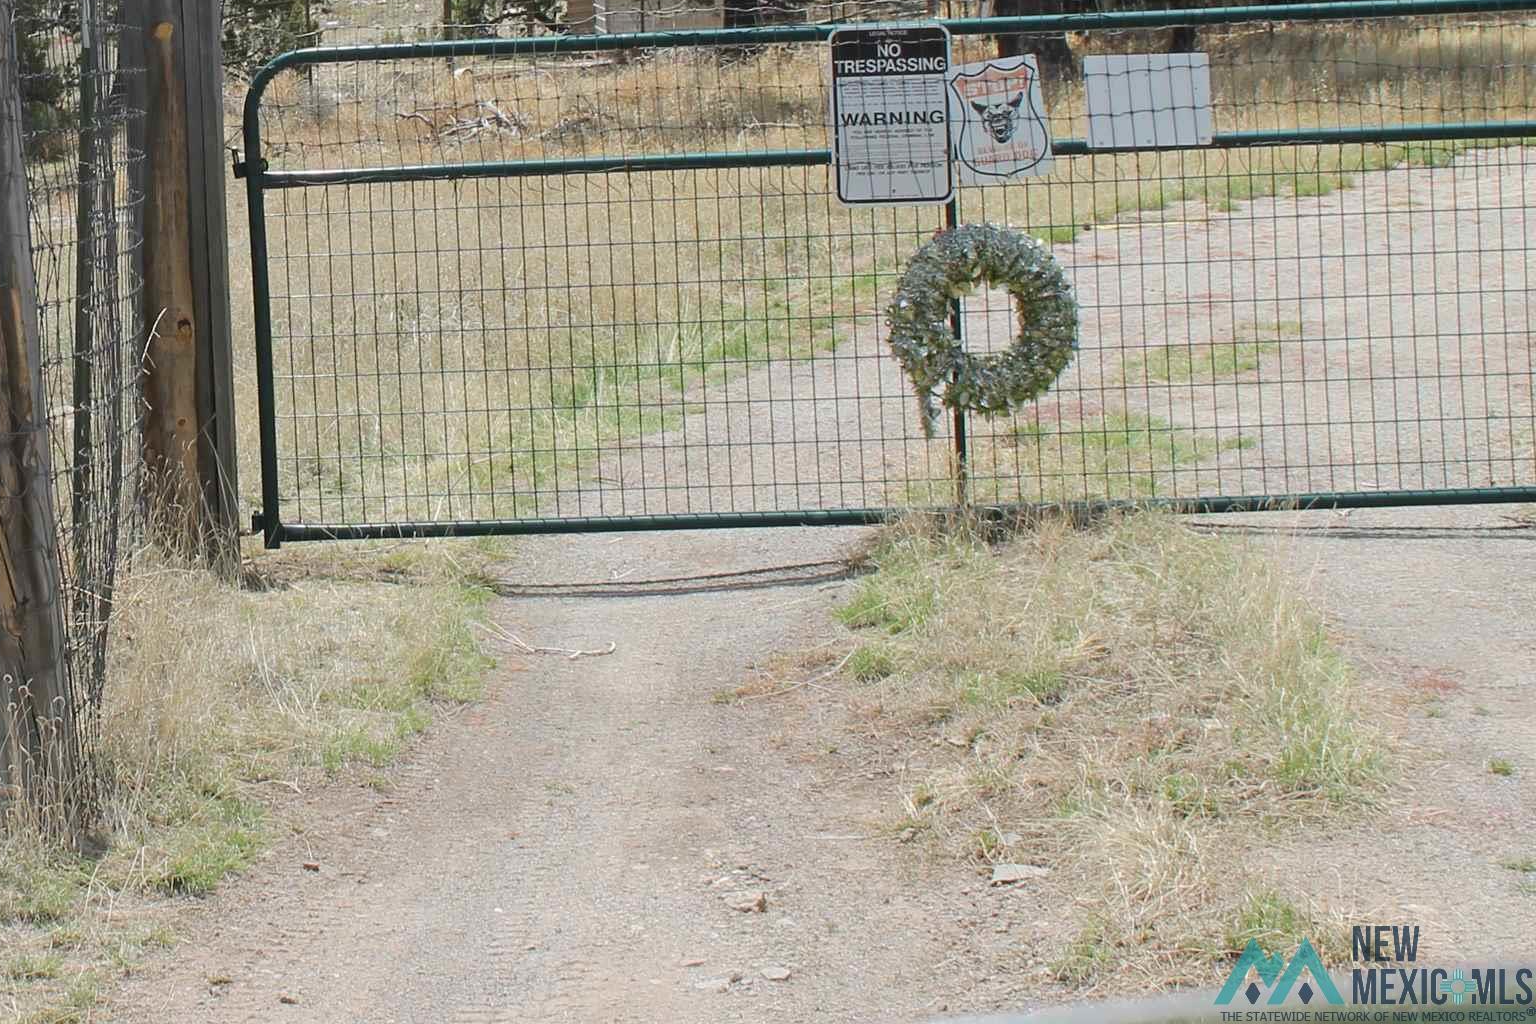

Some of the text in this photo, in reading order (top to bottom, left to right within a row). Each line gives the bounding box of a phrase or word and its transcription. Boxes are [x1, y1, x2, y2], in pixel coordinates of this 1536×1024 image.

[877, 43, 901, 57] NO
[834, 57, 946, 73] TRESPASSING
[841, 110, 944, 126] WARNING
